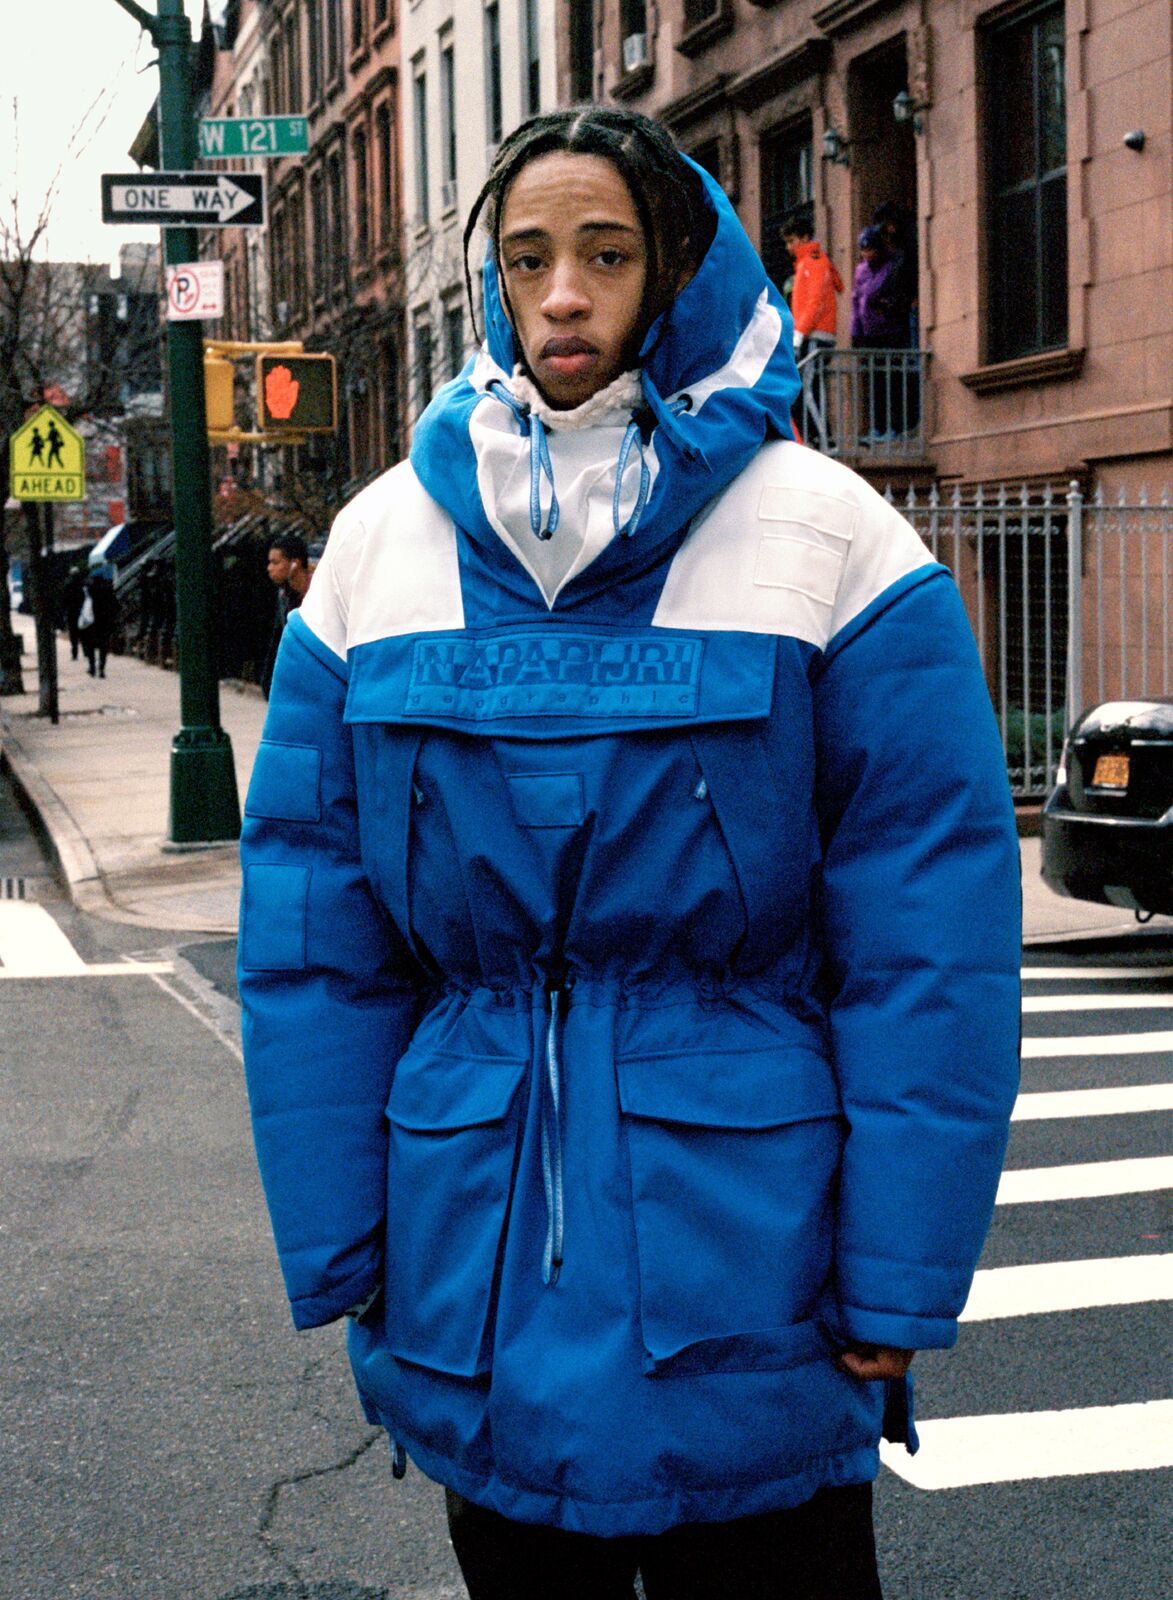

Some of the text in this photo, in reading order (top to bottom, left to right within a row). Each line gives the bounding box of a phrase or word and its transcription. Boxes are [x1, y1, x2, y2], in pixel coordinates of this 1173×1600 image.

[203, 120, 304, 154] W 121 ST
[124, 188, 239, 210] ONE WAY
[20, 477, 77, 494] AHEAD
[420, 640, 689, 685] NAPAPIJRI
[412, 690, 690, 709] geographic
